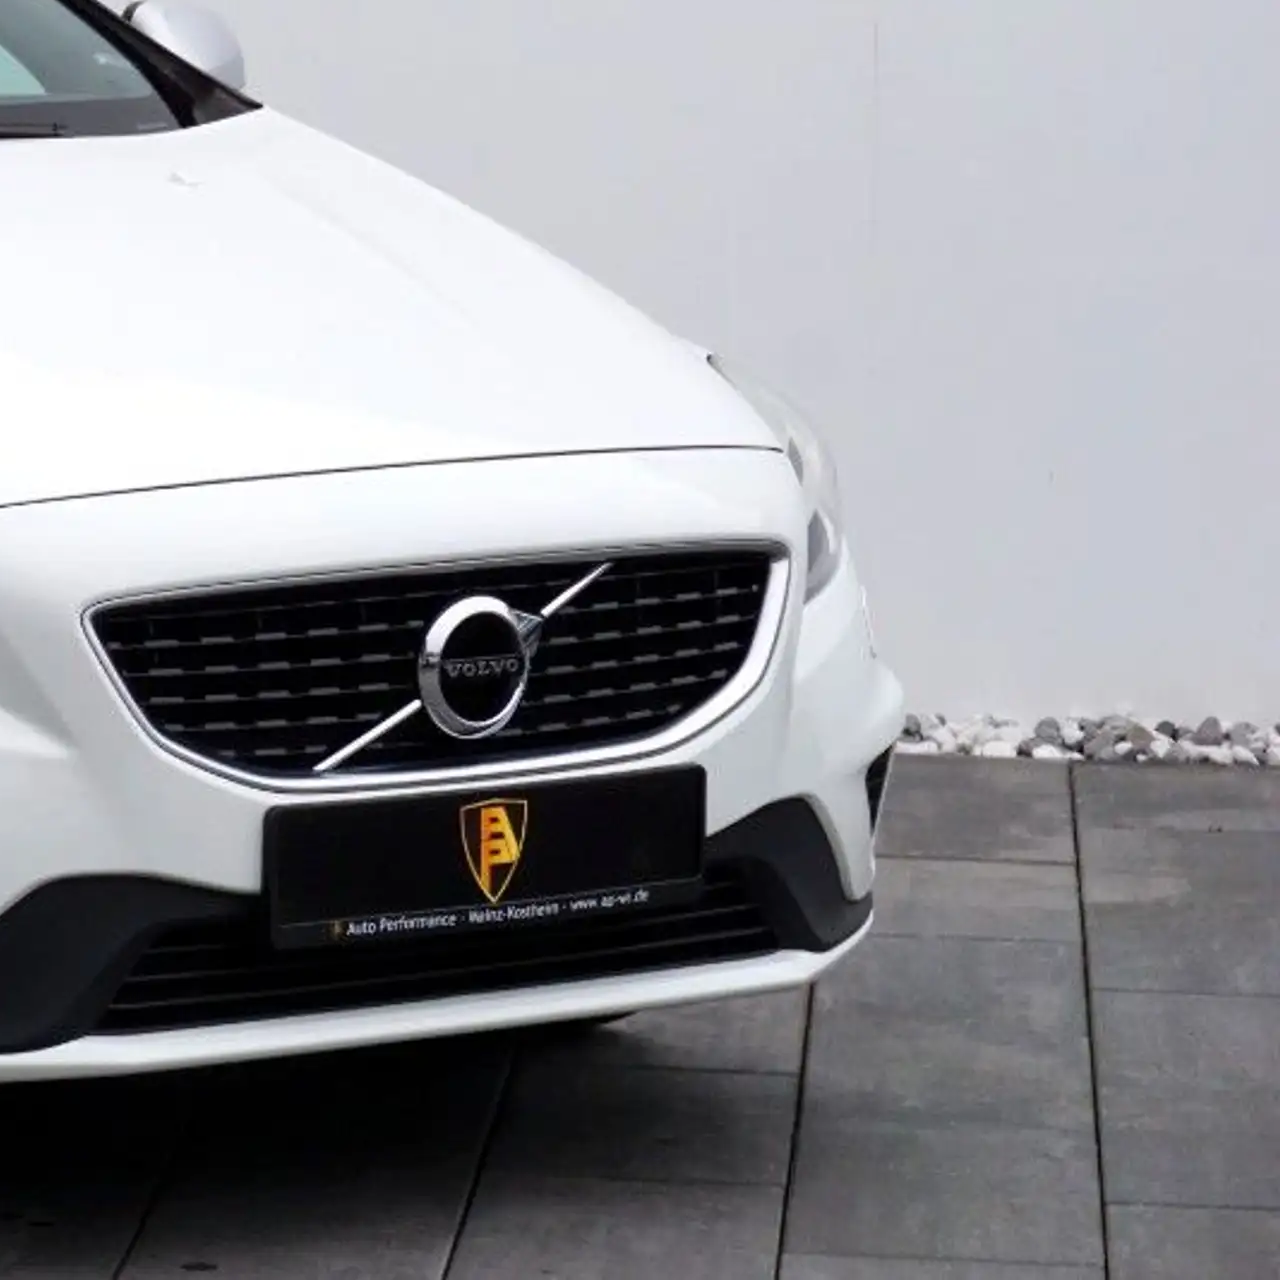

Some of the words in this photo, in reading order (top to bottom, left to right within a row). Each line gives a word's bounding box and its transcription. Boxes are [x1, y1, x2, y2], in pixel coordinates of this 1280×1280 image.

[444, 658, 520, 678] VOLVO
[345, 920, 377, 936] Auto
[379, 914, 457, 933] Performance
